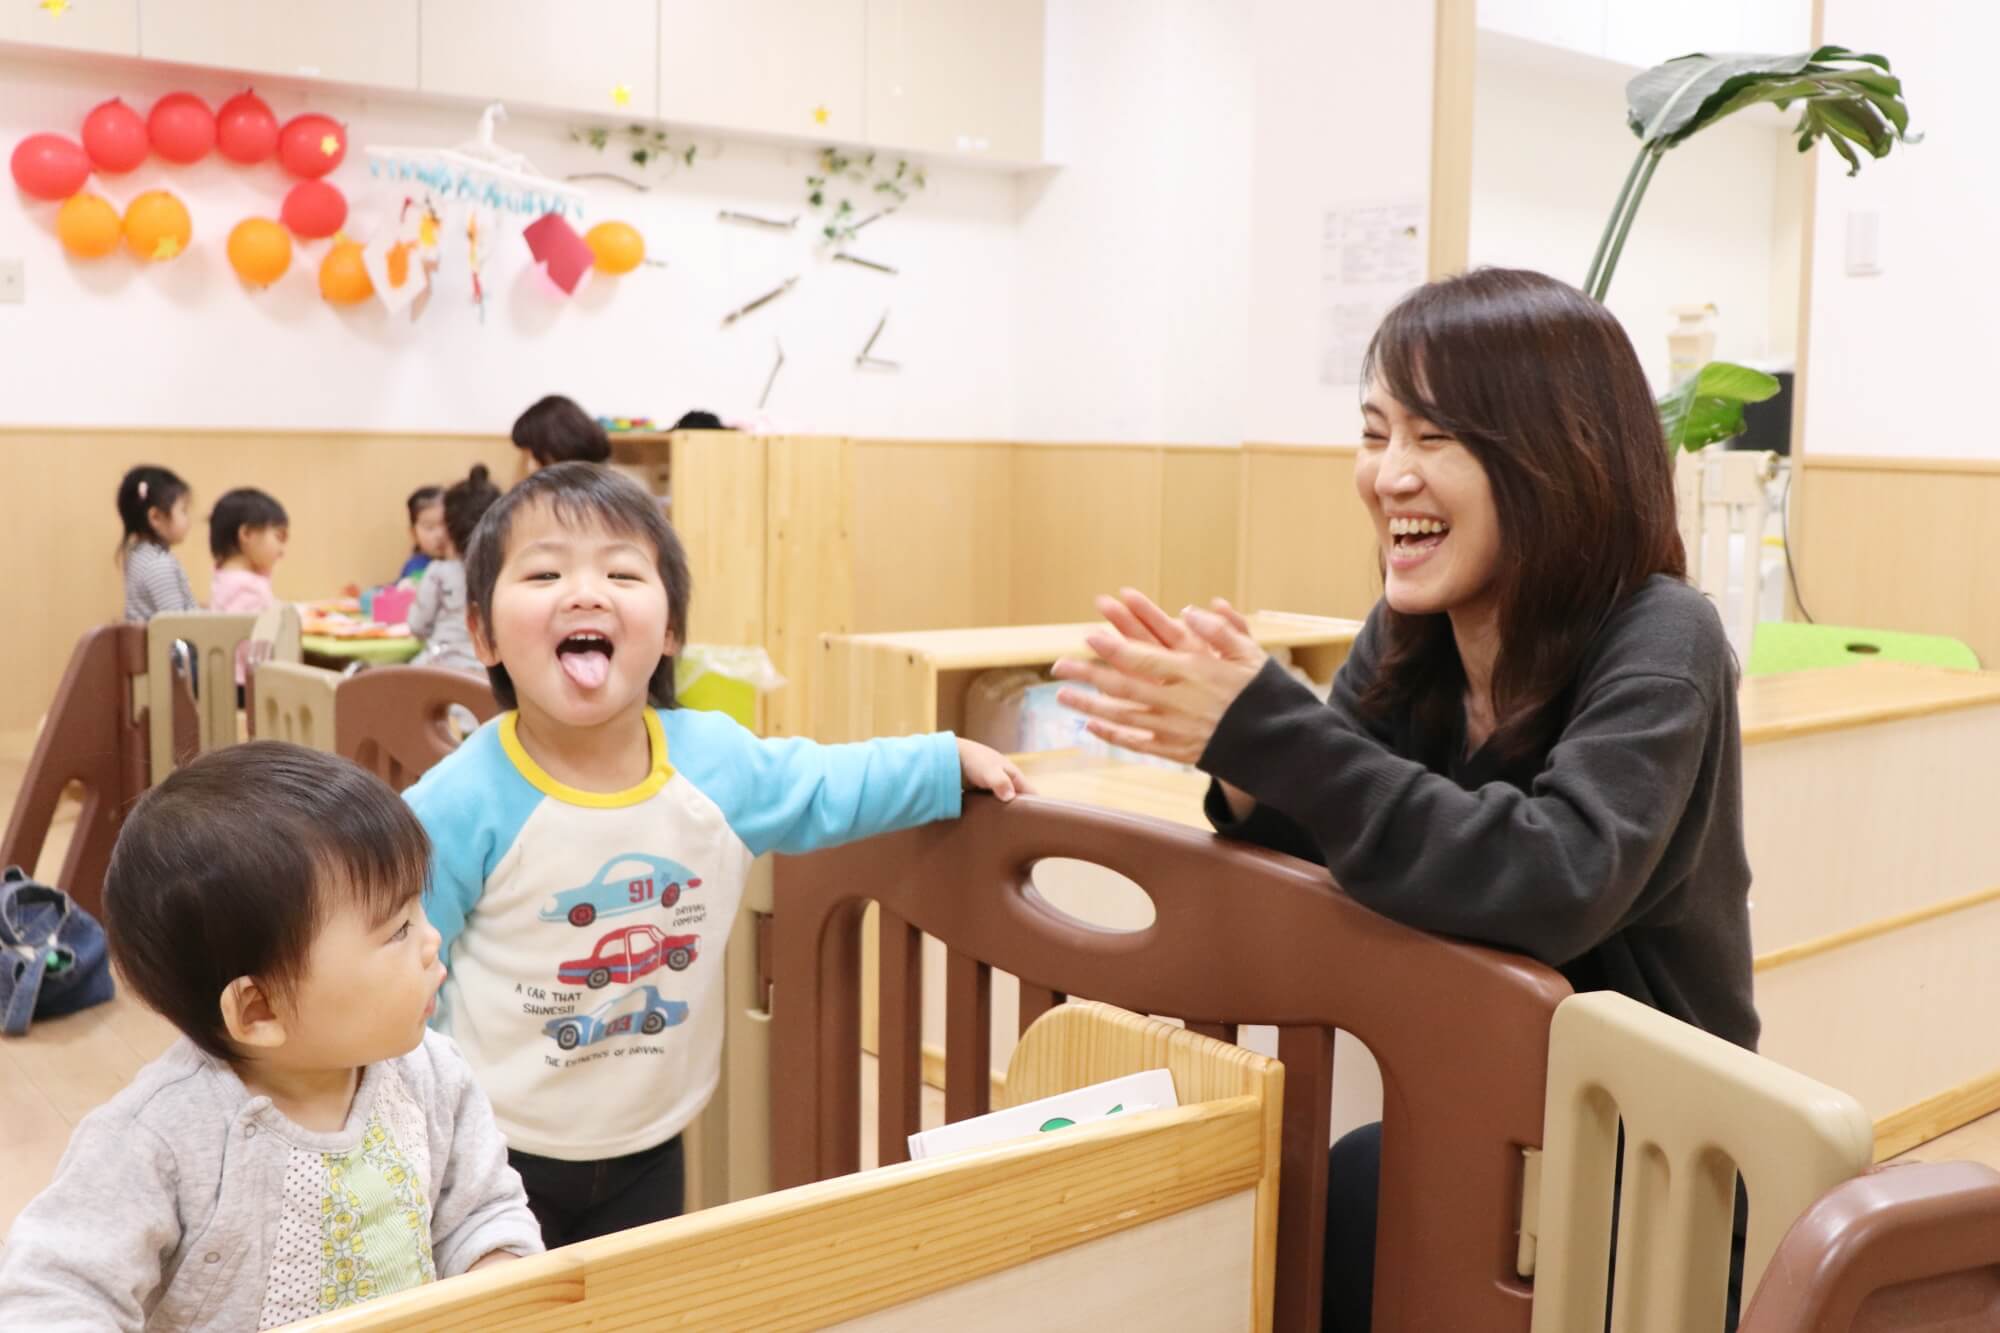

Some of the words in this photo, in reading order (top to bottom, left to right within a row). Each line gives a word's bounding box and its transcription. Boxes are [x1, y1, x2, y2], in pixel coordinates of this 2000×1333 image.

[629, 878, 654, 903] 91
[515, 983, 522, 994] A
[527, 986, 546, 1000] CAR
[551, 991, 583, 1002] THAT
[545, 1056, 560, 1067] THE
[614, 1048, 625, 1057] OF
[629, 1046, 665, 1055] DRIVING
